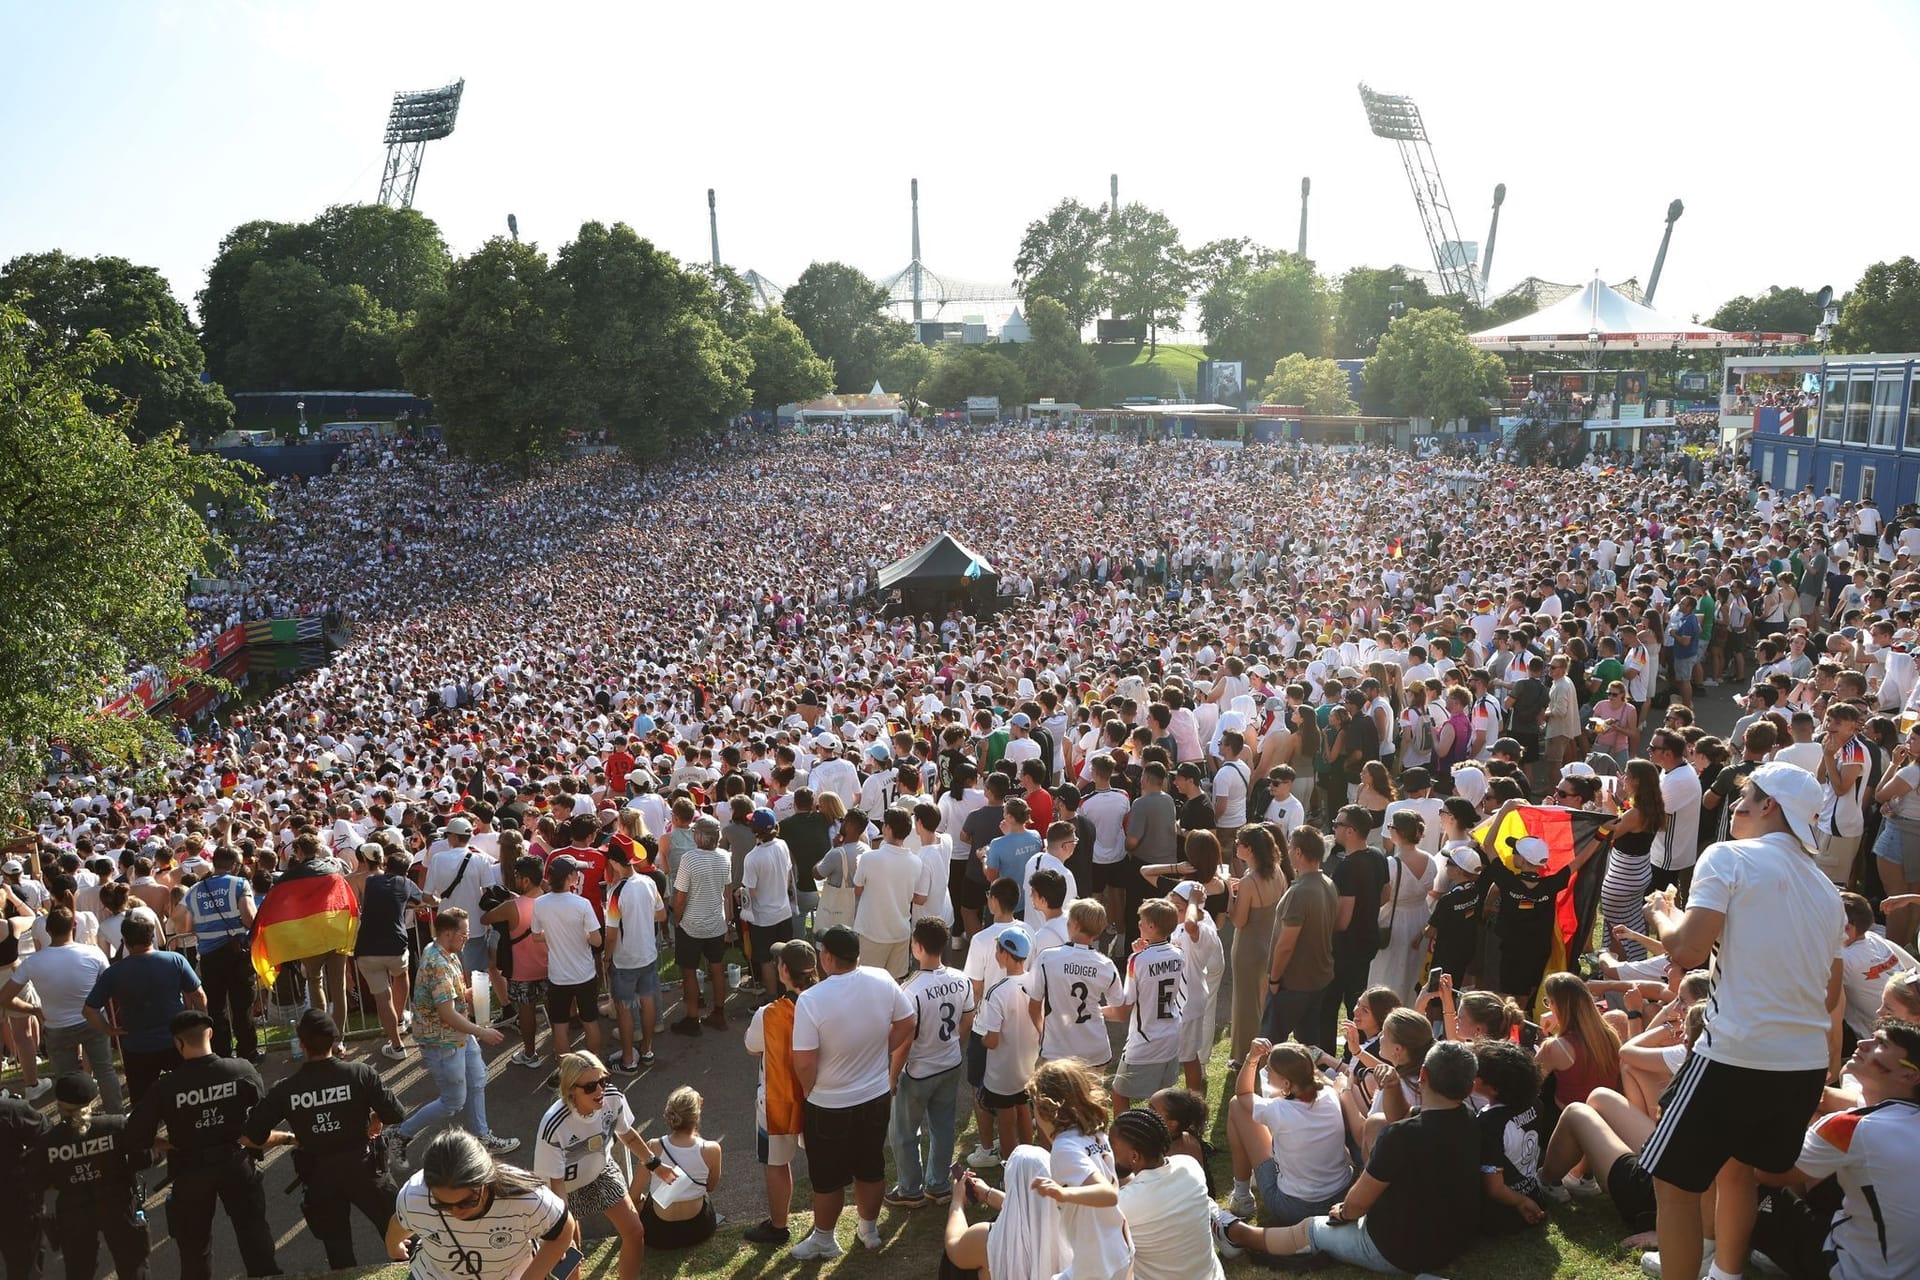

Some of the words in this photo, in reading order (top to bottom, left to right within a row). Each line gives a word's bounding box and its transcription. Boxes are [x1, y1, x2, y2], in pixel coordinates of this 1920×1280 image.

[1064, 962, 1098, 978] RÜDIGER
[925, 980, 965, 1001] KROOS
[1070, 981, 1092, 1024] 2
[175, 1081, 237, 1109] POLIZEI
[290, 1084, 352, 1111] POLIZEI
[202, 1107, 219, 1119] BY
[316, 1112, 332, 1124] BY
[195, 1114, 225, 1129] 6432
[311, 1121, 341, 1134] 6432
[47, 1134, 114, 1164] POLIZEI
[75, 1162, 92, 1174] BY
[70, 1170, 102, 1184] 6432
[448, 1250, 482, 1275] 20
